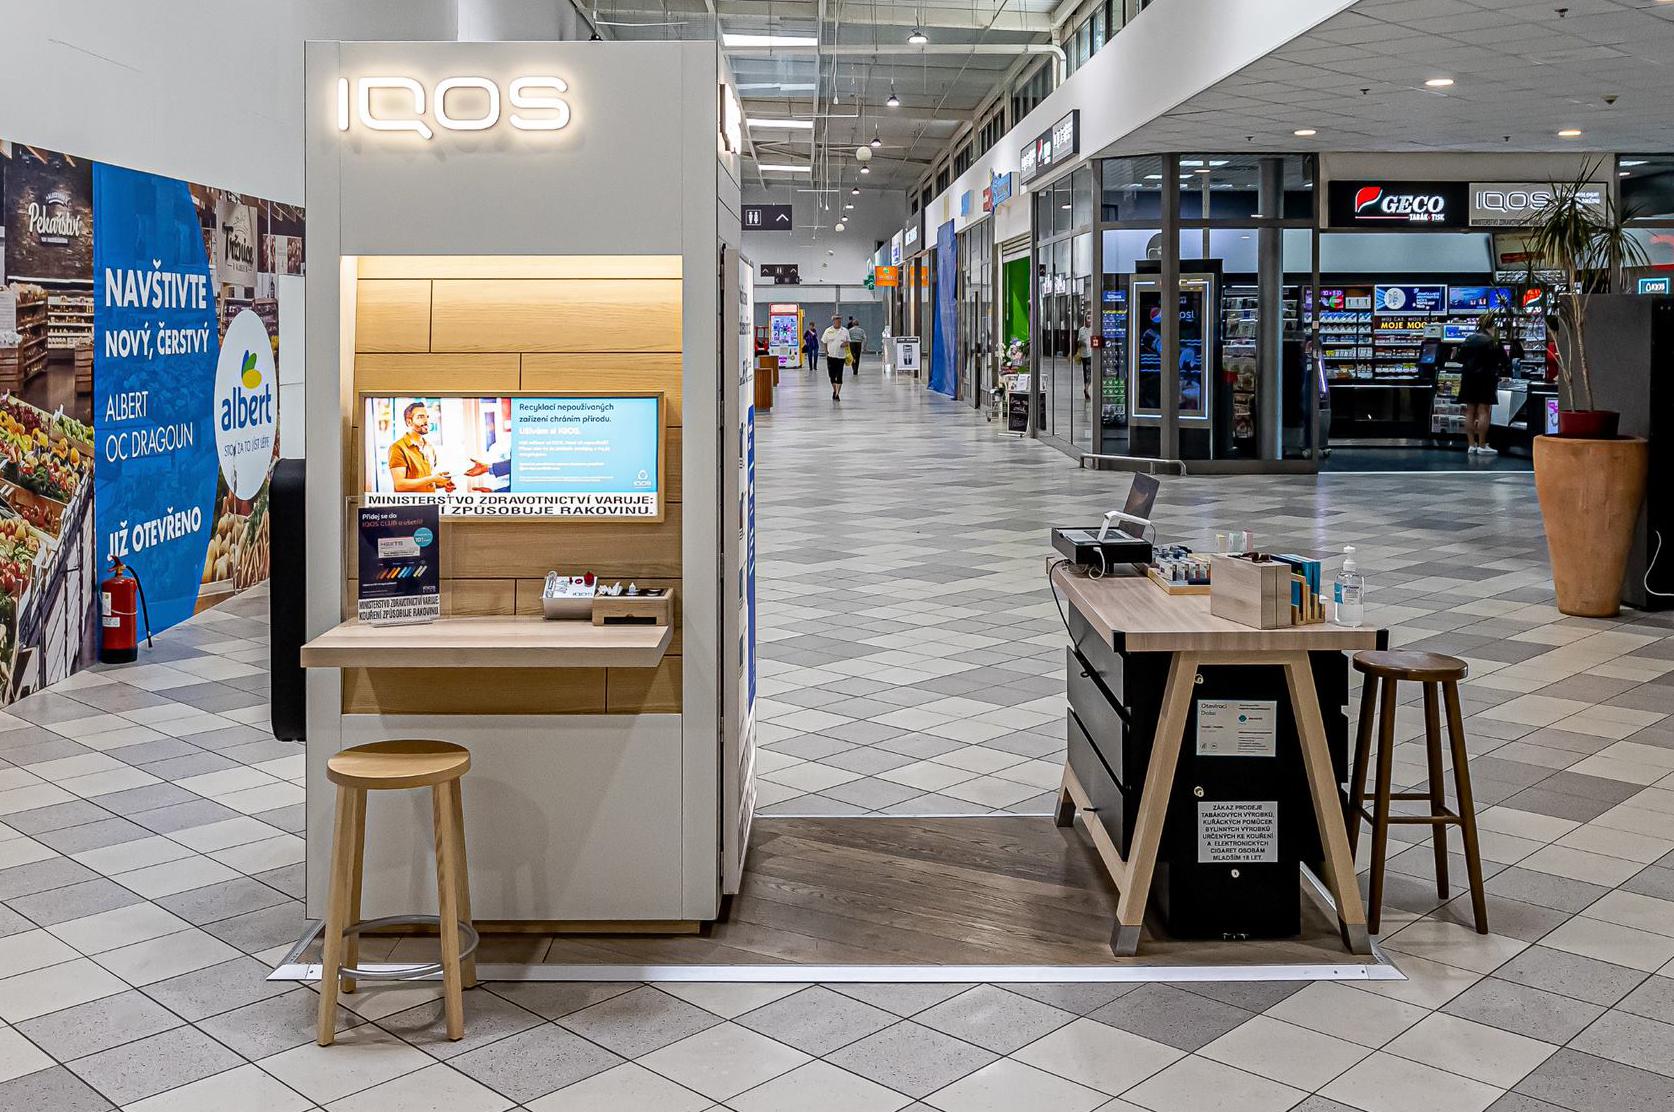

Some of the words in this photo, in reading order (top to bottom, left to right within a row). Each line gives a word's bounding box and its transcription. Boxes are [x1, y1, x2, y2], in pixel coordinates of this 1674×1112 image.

[337, 76, 571, 140] IQOS
[28, 202, 80, 237] Pekařství
[1381, 195, 1445, 213] GECO
[1476, 191, 1551, 213] IQOS
[105, 258, 207, 309] NAVŠTIVTE
[105, 321, 153, 360] NOVÝ,
[157, 321, 209, 356] ČERSTVÝ
[105, 391, 149, 422] ALBERT
[221, 383, 271, 431] albert
[106, 433, 128, 462] OC
[132, 422, 193, 458] DRAGOUN
[368, 495, 474, 504] MINISTERSTVO
[479, 494, 591, 504] ZDRAVOTNICTVÍ
[595, 496, 653, 504] VARUJE:
[448, 505, 554, 515] ZPŮSOBUJE
[560, 506, 653, 515] RAKOVINU.
[107, 520, 129, 561] JIŽ
[132, 506, 201, 552] OTEVŘENO
